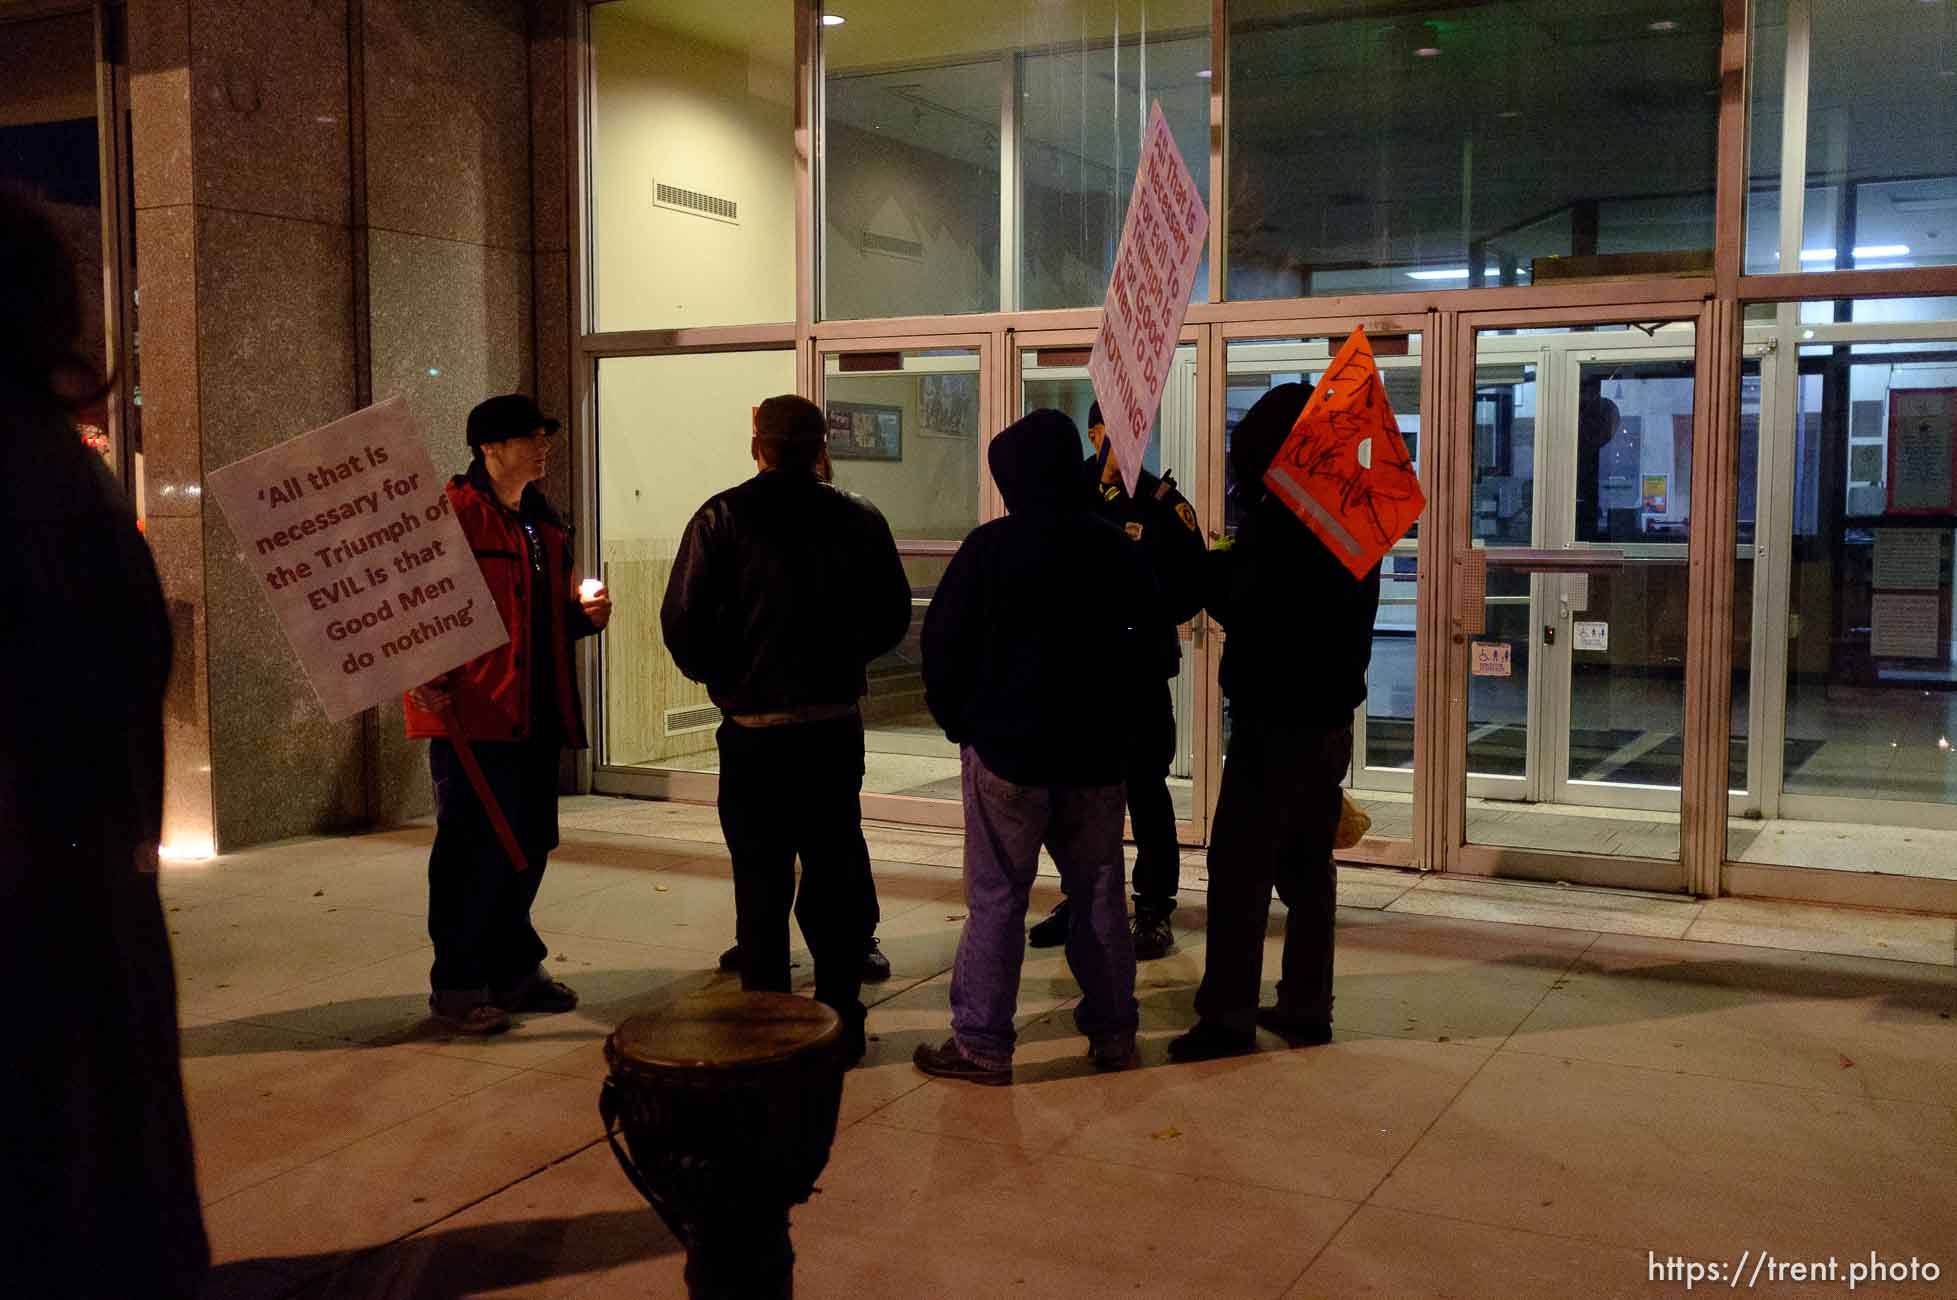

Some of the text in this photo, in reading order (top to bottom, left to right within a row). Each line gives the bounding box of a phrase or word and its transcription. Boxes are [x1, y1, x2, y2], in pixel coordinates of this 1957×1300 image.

[1148, 154, 1189, 263] Necessary
[1166, 154, 1187, 214] That
[1133, 214, 1162, 308] Triumph
[1138, 188, 1178, 298] For Evil To
[1113, 261, 1157, 395] Men To Do
[1124, 246, 1164, 359] For Good
[305, 457, 365, 489] that
[365, 447, 387, 466] is
[257, 474, 417, 554] necessary for
[267, 495, 448, 588] the Triumph of
[306, 542, 445, 609] EVIL is that
[327, 579, 453, 640] Good Men
[343, 653, 374, 673] do
